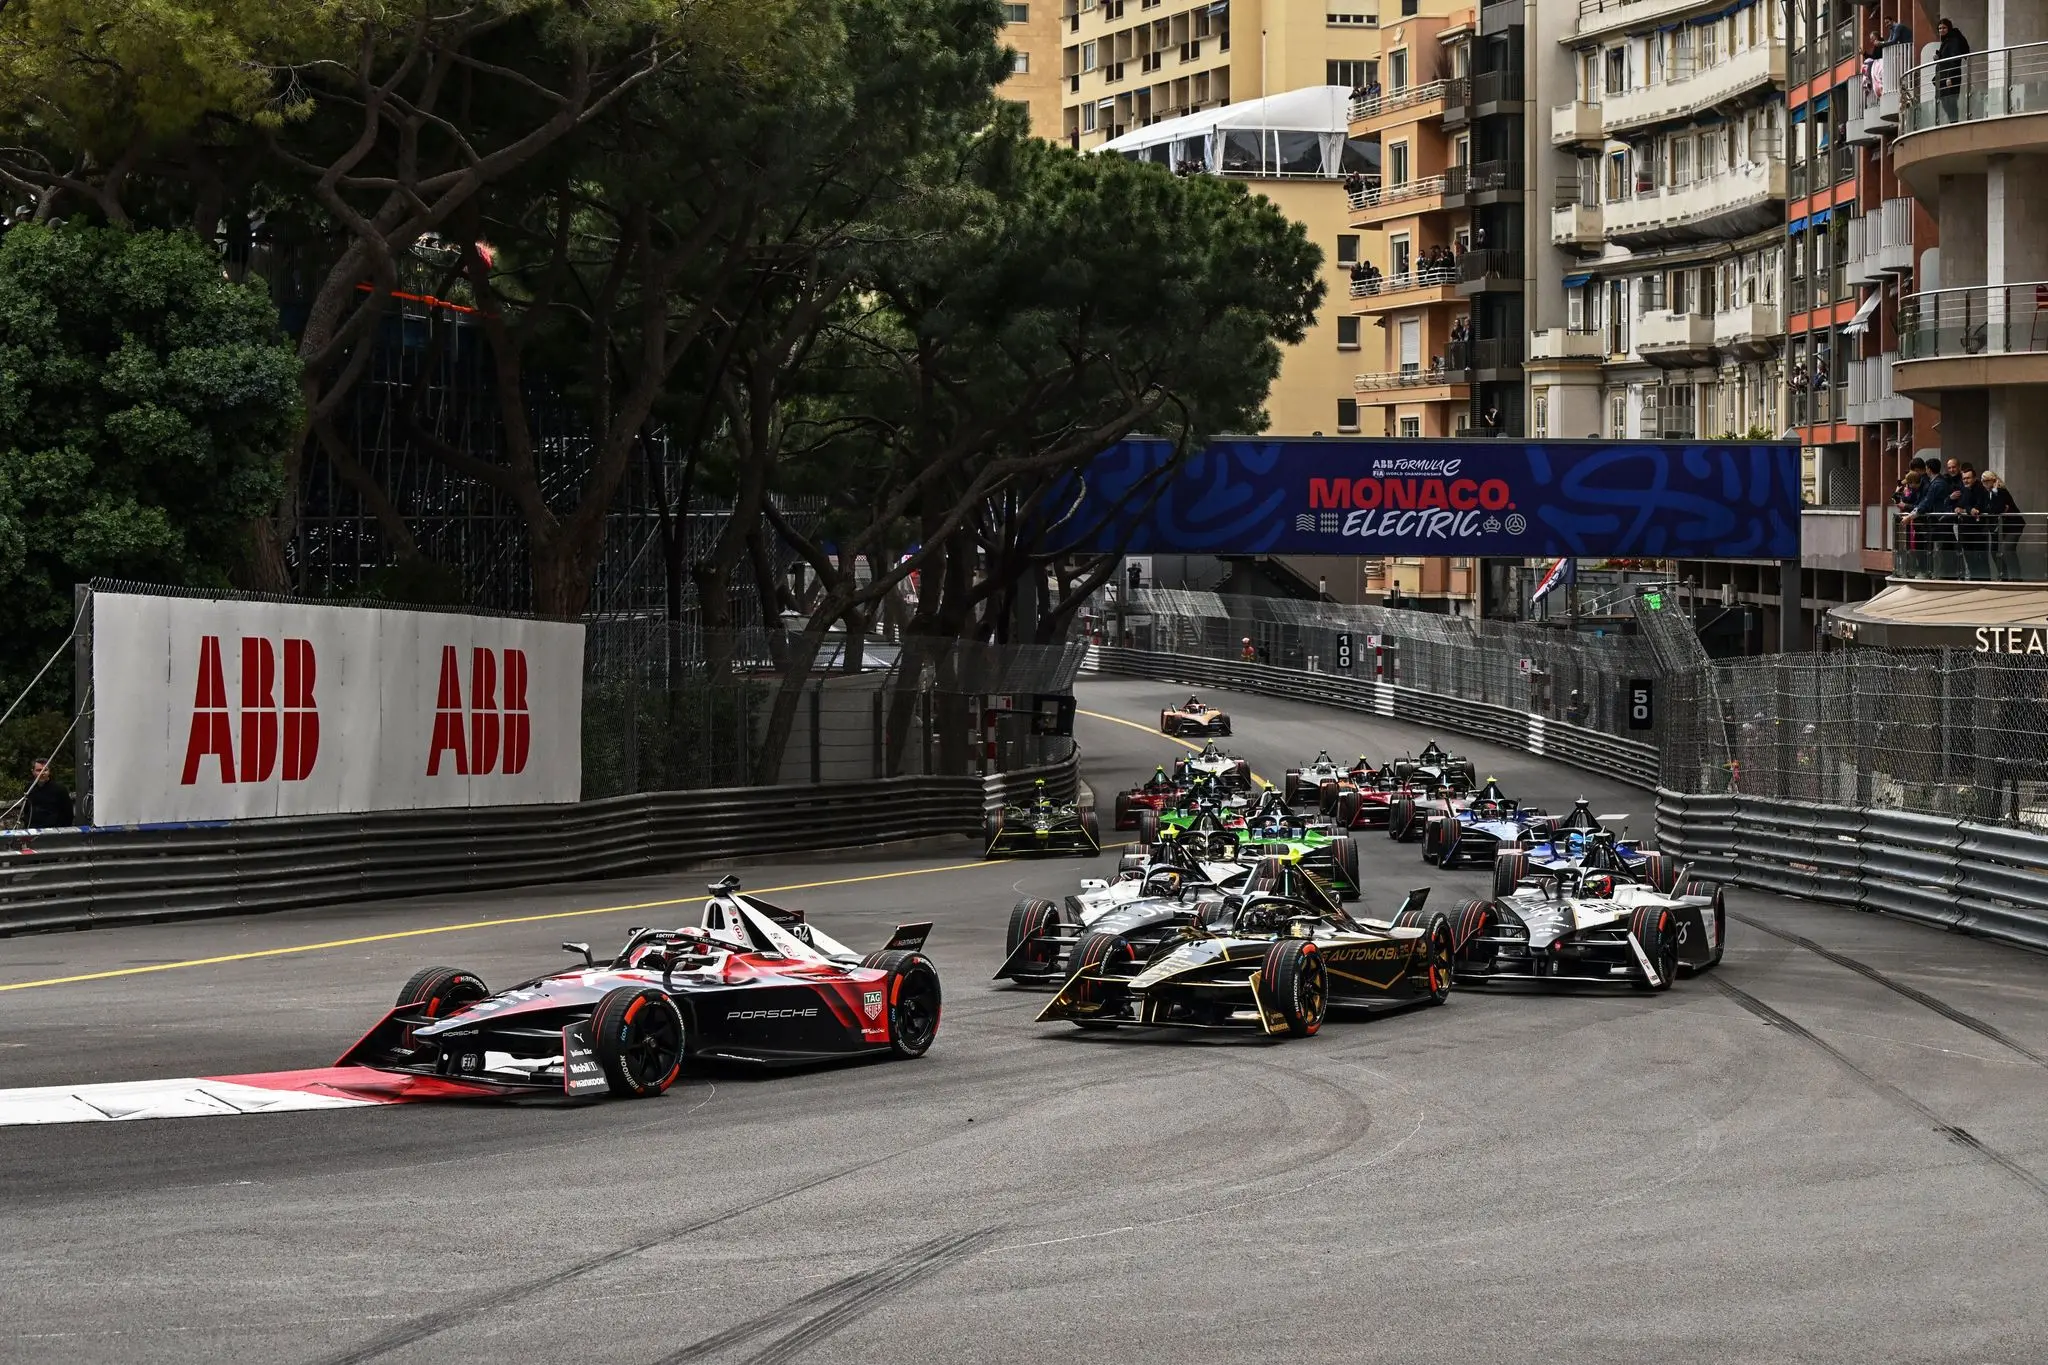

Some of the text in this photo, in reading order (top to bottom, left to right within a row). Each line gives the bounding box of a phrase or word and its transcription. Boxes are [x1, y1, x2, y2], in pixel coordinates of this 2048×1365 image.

[1373, 459, 1393, 468] ABB
[1394, 459, 1445, 470] FORMULA
[1975, 627, 2048, 655] STEA
[1633, 689, 1648, 719] 50
[181, 636, 320, 785] ABB
[426, 645, 531, 776] ABB
[866, 993, 881, 1003] TAG
[727, 1008, 818, 1020] PORSCHE
[864, 1003, 882, 1015] HEUER
[442, 1029, 479, 1037] PORSCHE
[570, 1062, 590, 1074] Mobil
